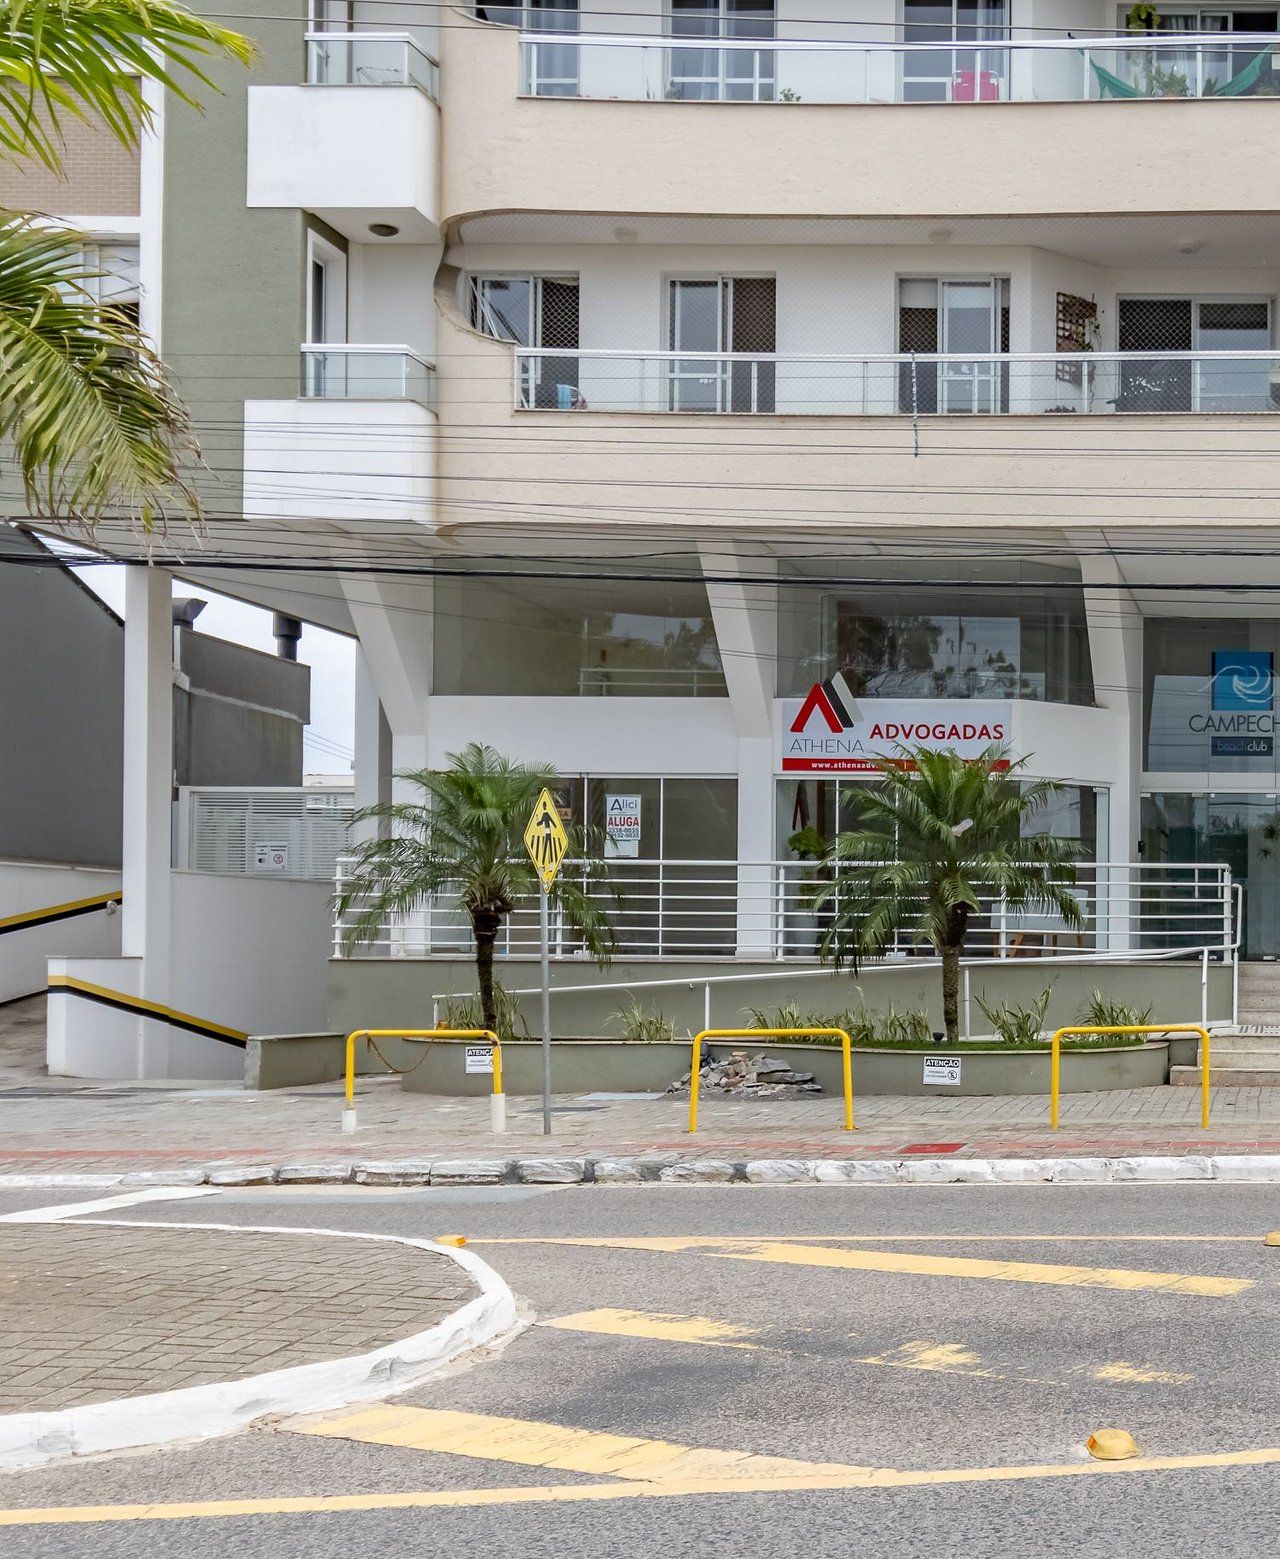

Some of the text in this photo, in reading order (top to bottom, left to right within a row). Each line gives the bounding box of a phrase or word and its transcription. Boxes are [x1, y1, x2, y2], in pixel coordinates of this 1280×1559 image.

[869, 723, 1004, 740] ADVOGADAS
[789, 738, 864, 753] ATHENA
[610, 799, 638, 811] Alici
[608, 817, 640, 827] ALUGA
[925, 1058, 959, 1068] ATENÇÃO
